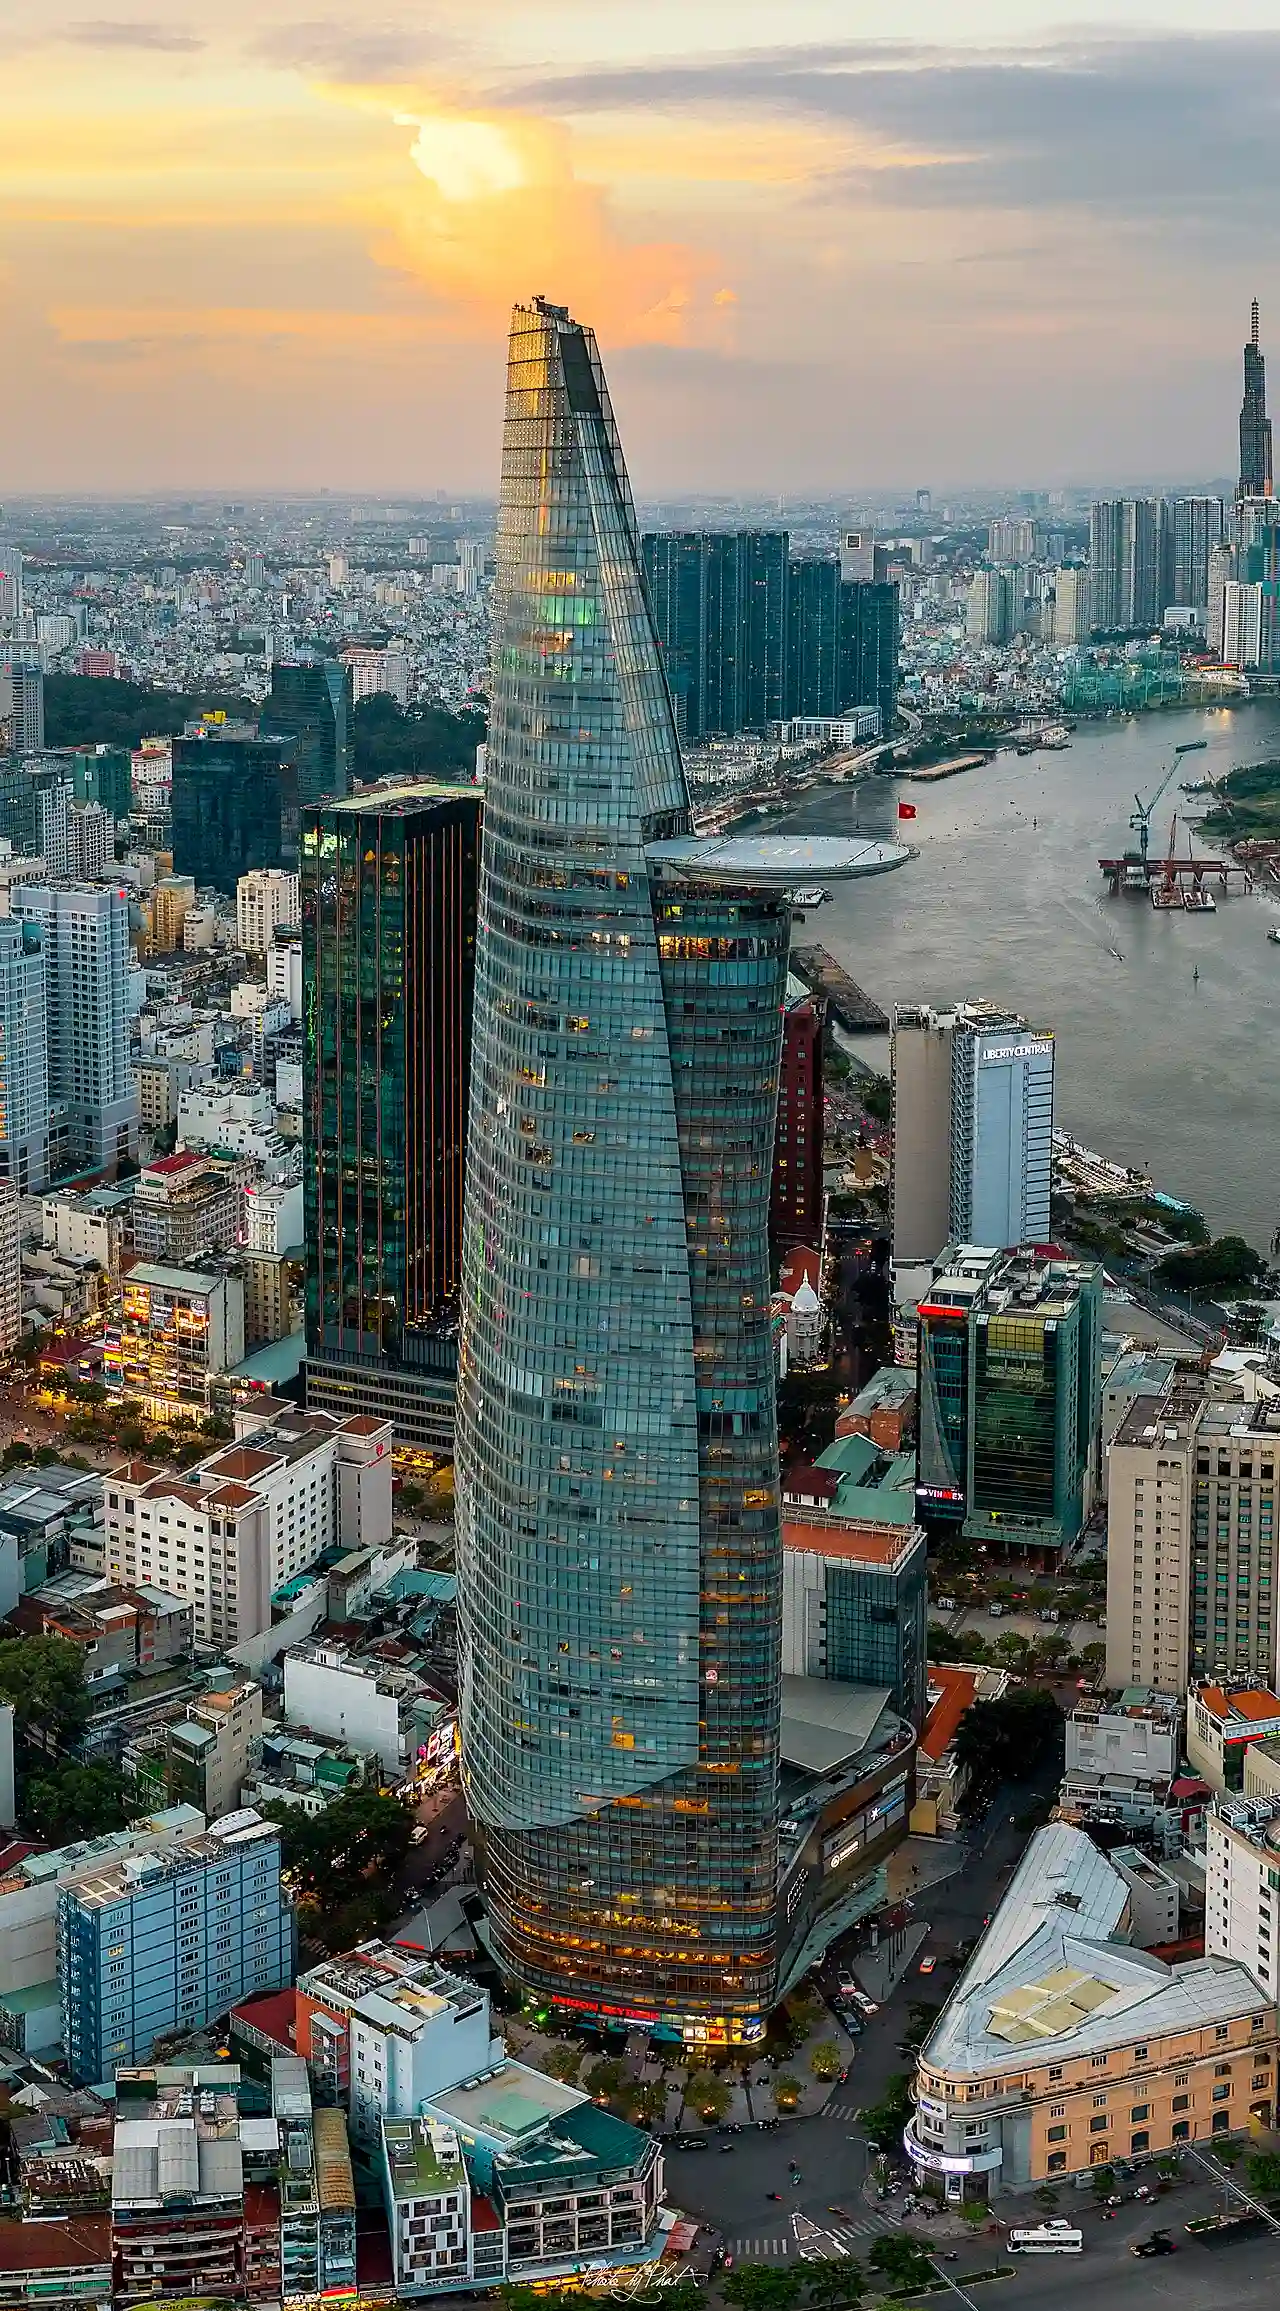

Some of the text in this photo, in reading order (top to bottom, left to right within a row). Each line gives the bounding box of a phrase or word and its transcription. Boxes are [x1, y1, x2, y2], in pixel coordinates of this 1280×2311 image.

[983, 1044, 1051, 1060] LIBERTY CENTRAL
[602, 2004, 660, 2020] SKYD
